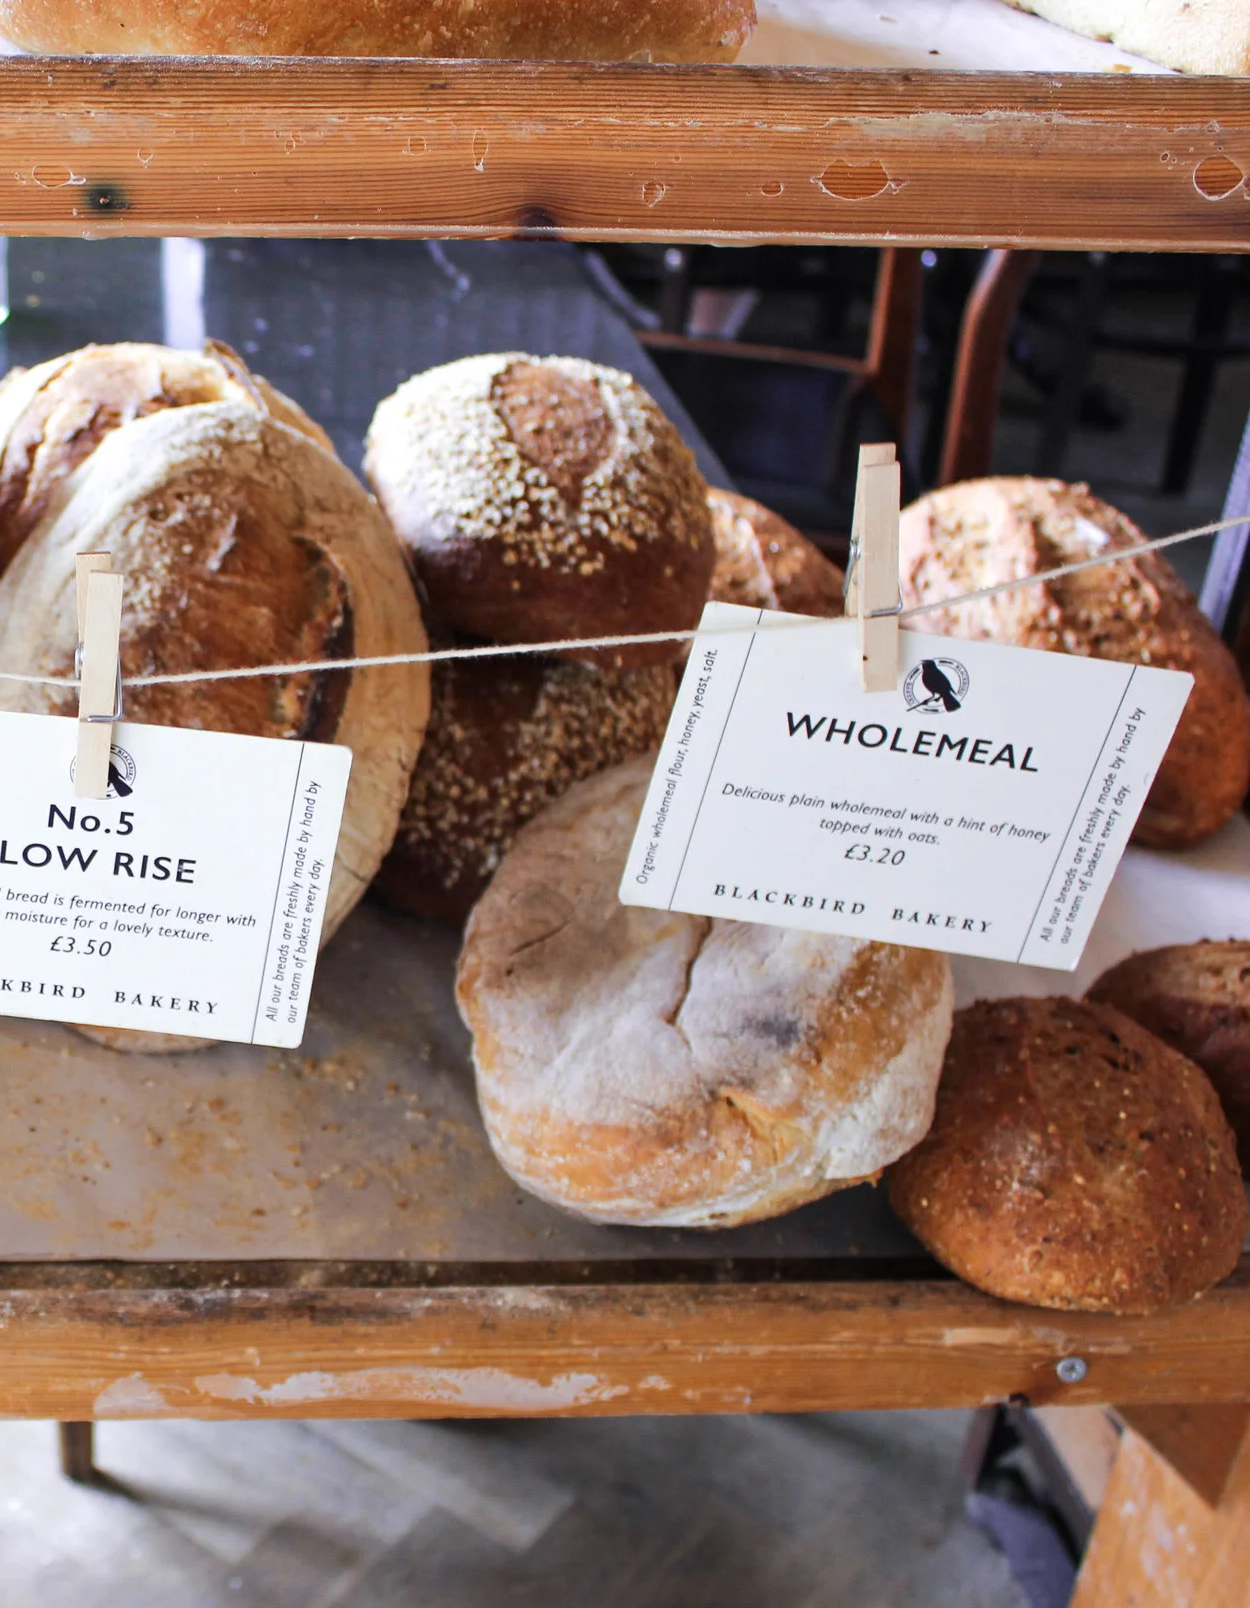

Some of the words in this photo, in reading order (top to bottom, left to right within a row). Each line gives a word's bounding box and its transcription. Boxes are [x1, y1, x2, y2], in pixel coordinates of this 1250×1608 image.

[702, 649, 718, 673] salt.
[692, 675, 712, 708] yeast,
[677, 710, 701, 746] honey,
[1128, 706, 1146, 721] by
[786, 711, 1038, 773] WHOLEMEAL
[1114, 723, 1137, 754] hand
[667, 748, 689, 777] flour,
[1108, 755, 1126, 770] by
[304, 780, 322, 794] by
[1097, 772, 1117, 805] made
[1112, 784, 1131, 806] day.
[47, 803, 134, 836] No.5
[298, 796, 316, 827] hand
[651, 777, 677, 838] wholemeal
[721, 782, 786, 803] Delicious
[788, 793, 825, 808] plain
[830, 799, 907, 819] wholemeal
[909, 811, 939, 824] with
[943, 817, 954, 827] a
[957, 816, 986, 832] hint
[989, 822, 1009, 837] of
[1007, 823, 1051, 844] honey
[295, 829, 313, 843] by
[819, 818, 871, 835] topped
[873, 826, 903, 839] with
[907, 832, 939, 845] oats.
[1078, 806, 1104, 843] freshly
[1100, 808, 1121, 839] every
[112, 851, 196, 884] RISE
[293, 846, 307, 879] made
[308, 858, 325, 880] day.
[635, 841, 659, 884] Organic
[843, 843, 906, 866] £3.20
[1073, 846, 1089, 864] are
[1082, 841, 1106, 878] bakers
[304, 882, 321, 913] every
[1053, 867, 1084, 904] breads
[1078, 878, 1092, 892] of
[5, 888, 49, 904] bread
[53, 893, 64, 906] is
[69, 894, 146, 915] fermented
[149, 903, 171, 918] for
[175, 906, 221, 925] longer
[226, 914, 256, 927] with
[282, 881, 304, 919] freshly
[713, 883, 865, 914] BLACKBIRD
[891, 908, 991, 933] BAKERY
[1065, 895, 1083, 922] team
[4, 910, 68, 926] moisture
[72, 914, 94, 930] for
[98, 921, 108, 930] a
[113, 919, 153, 938] lovely
[158, 926, 213, 942] texture.
[1048, 905, 1067, 925] our
[282, 921, 293, 940] are
[295, 917, 312, 954] bakers
[1039, 926, 1053, 942] All
[1060, 925, 1073, 944] our
[49, 935, 112, 957] £3.50
[271, 944, 294, 981] breads
[293, 954, 307, 969] of
[271, 984, 282, 1003] our
[287, 972, 302, 1001] team
[114, 991, 218, 1014] BAKERY
[265, 1005, 278, 1022] All
[287, 1004, 298, 1024] our
